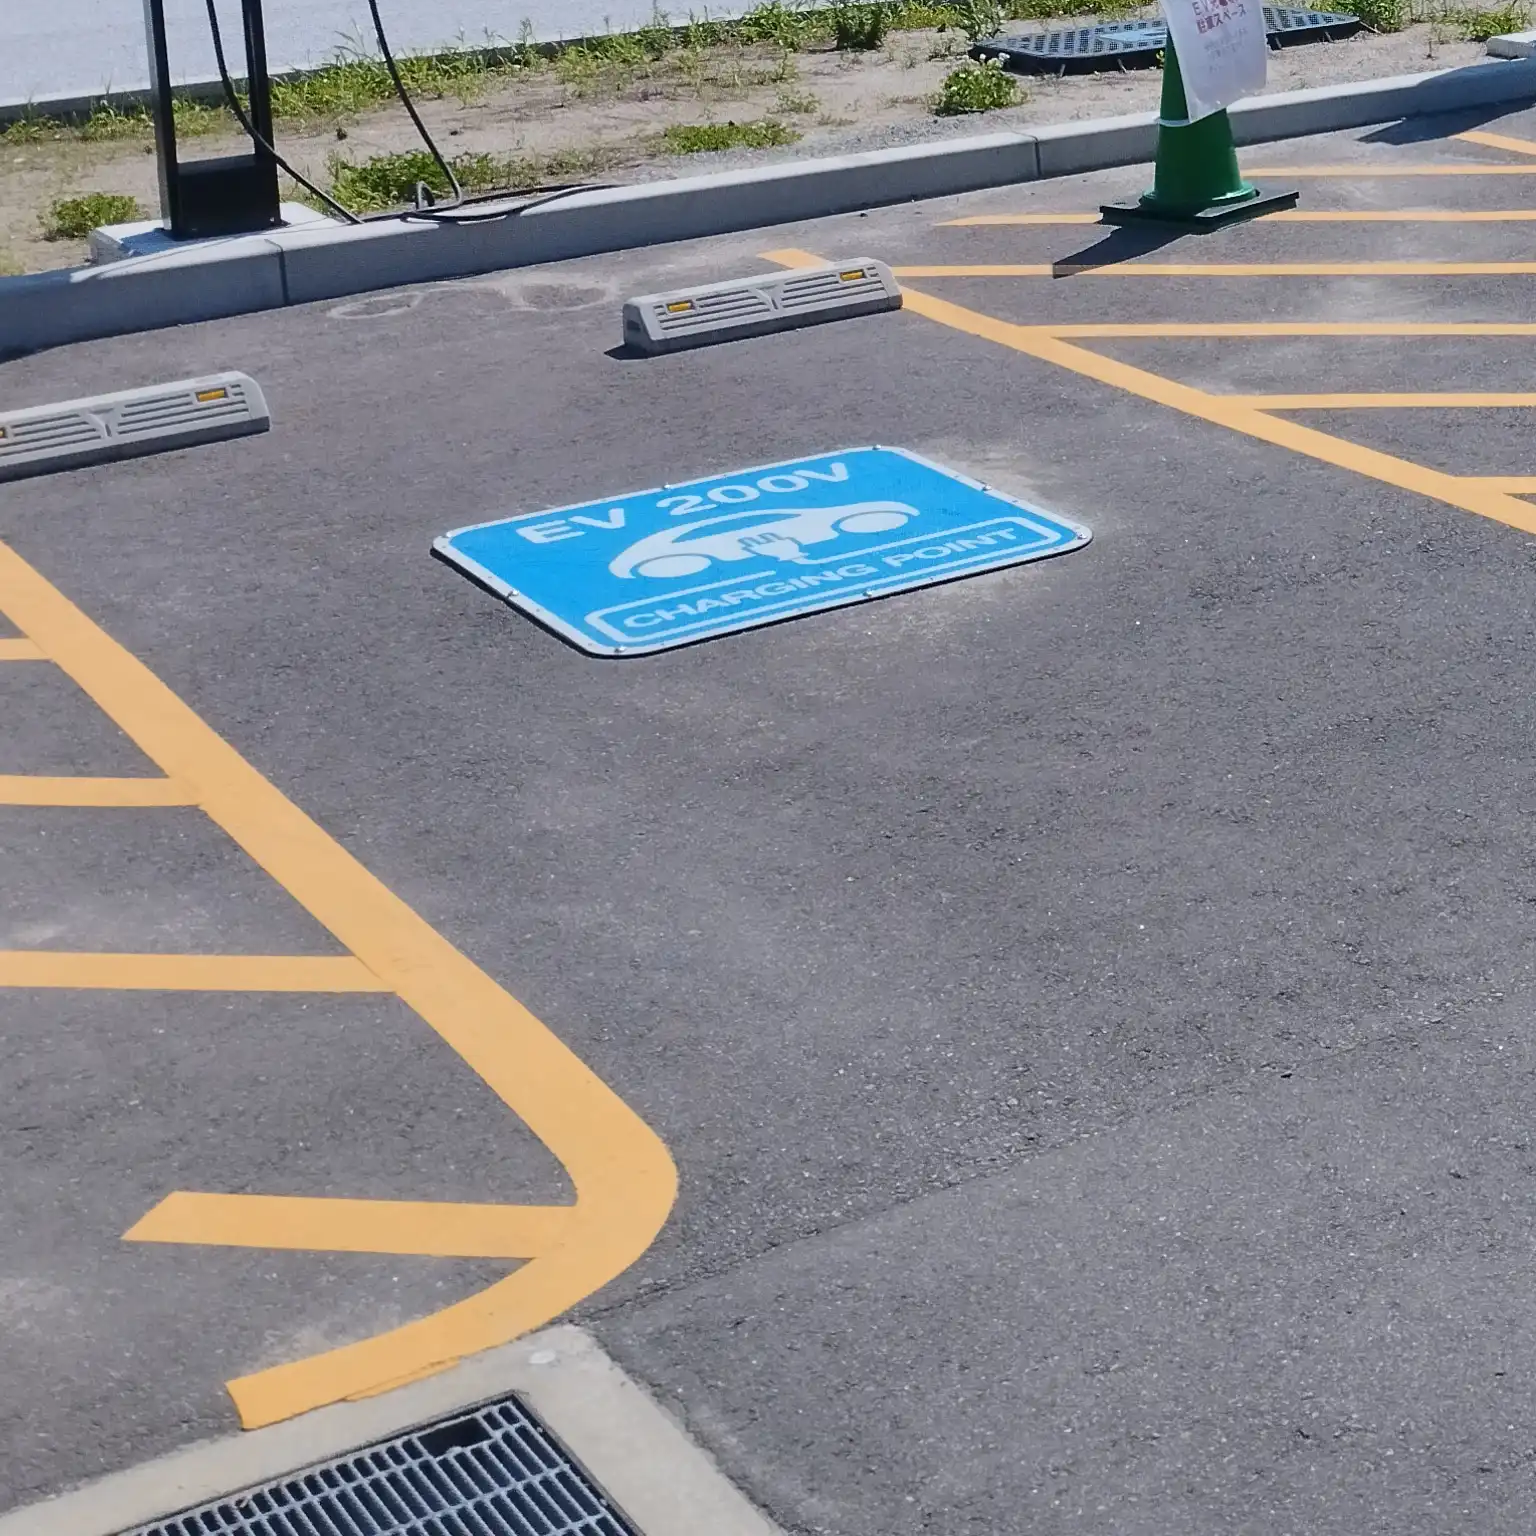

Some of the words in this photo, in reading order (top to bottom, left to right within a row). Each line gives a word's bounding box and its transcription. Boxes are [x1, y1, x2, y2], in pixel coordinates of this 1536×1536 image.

[515, 507, 626, 545] EV
[655, 462, 850, 517] 200V
[622, 563, 881, 628] CHARGING
[883, 528, 1019, 567] POINT
